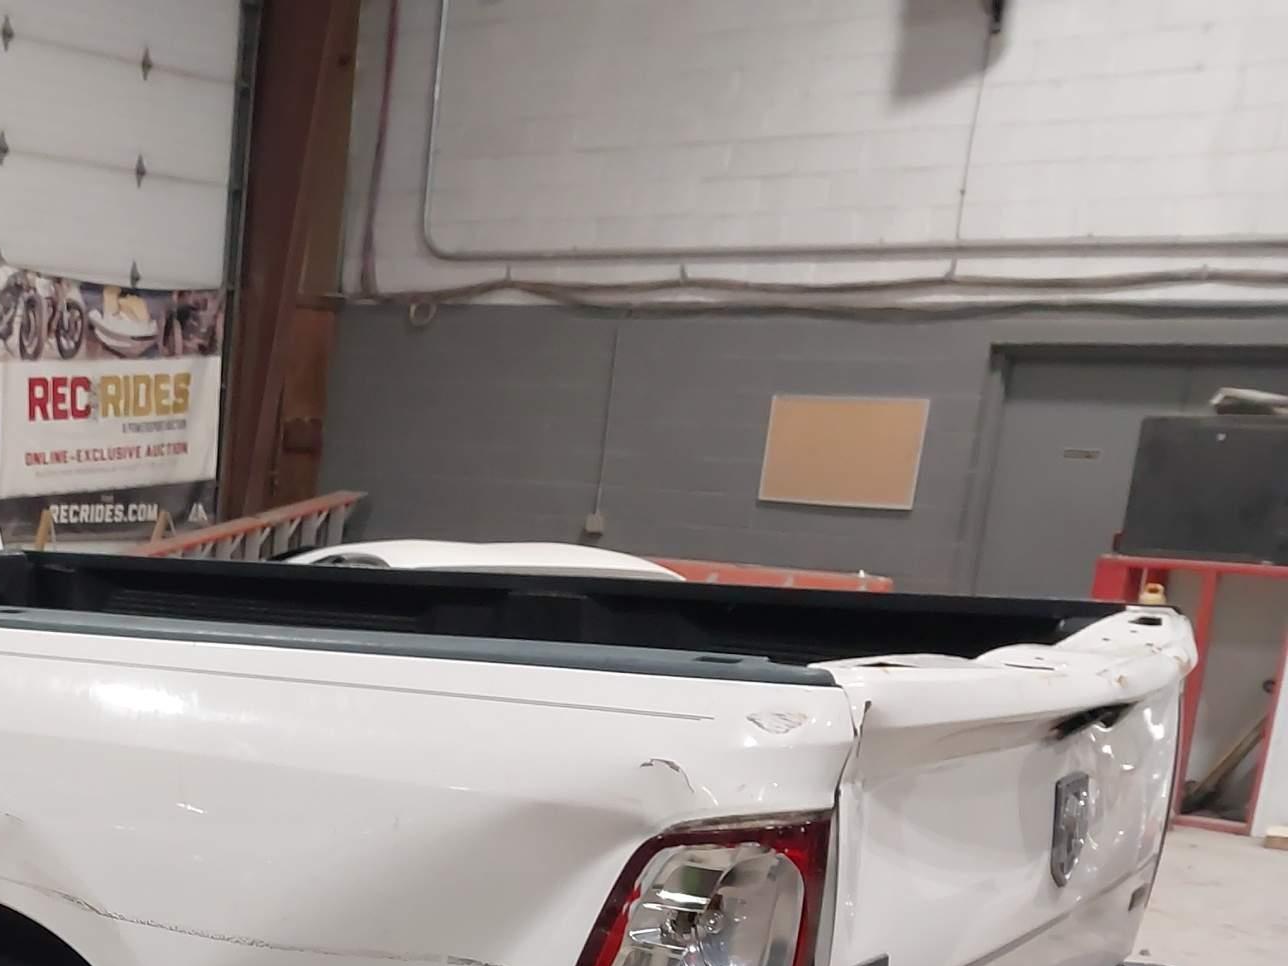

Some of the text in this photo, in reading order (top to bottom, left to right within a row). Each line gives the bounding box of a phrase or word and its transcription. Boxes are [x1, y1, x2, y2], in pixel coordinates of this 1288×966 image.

[27, 376, 92, 421] REC
[99, 372, 191, 417] RIDES
[145, 441, 189, 458] AUCTION
[49, 503, 158, 524] RECRIDES.COM
